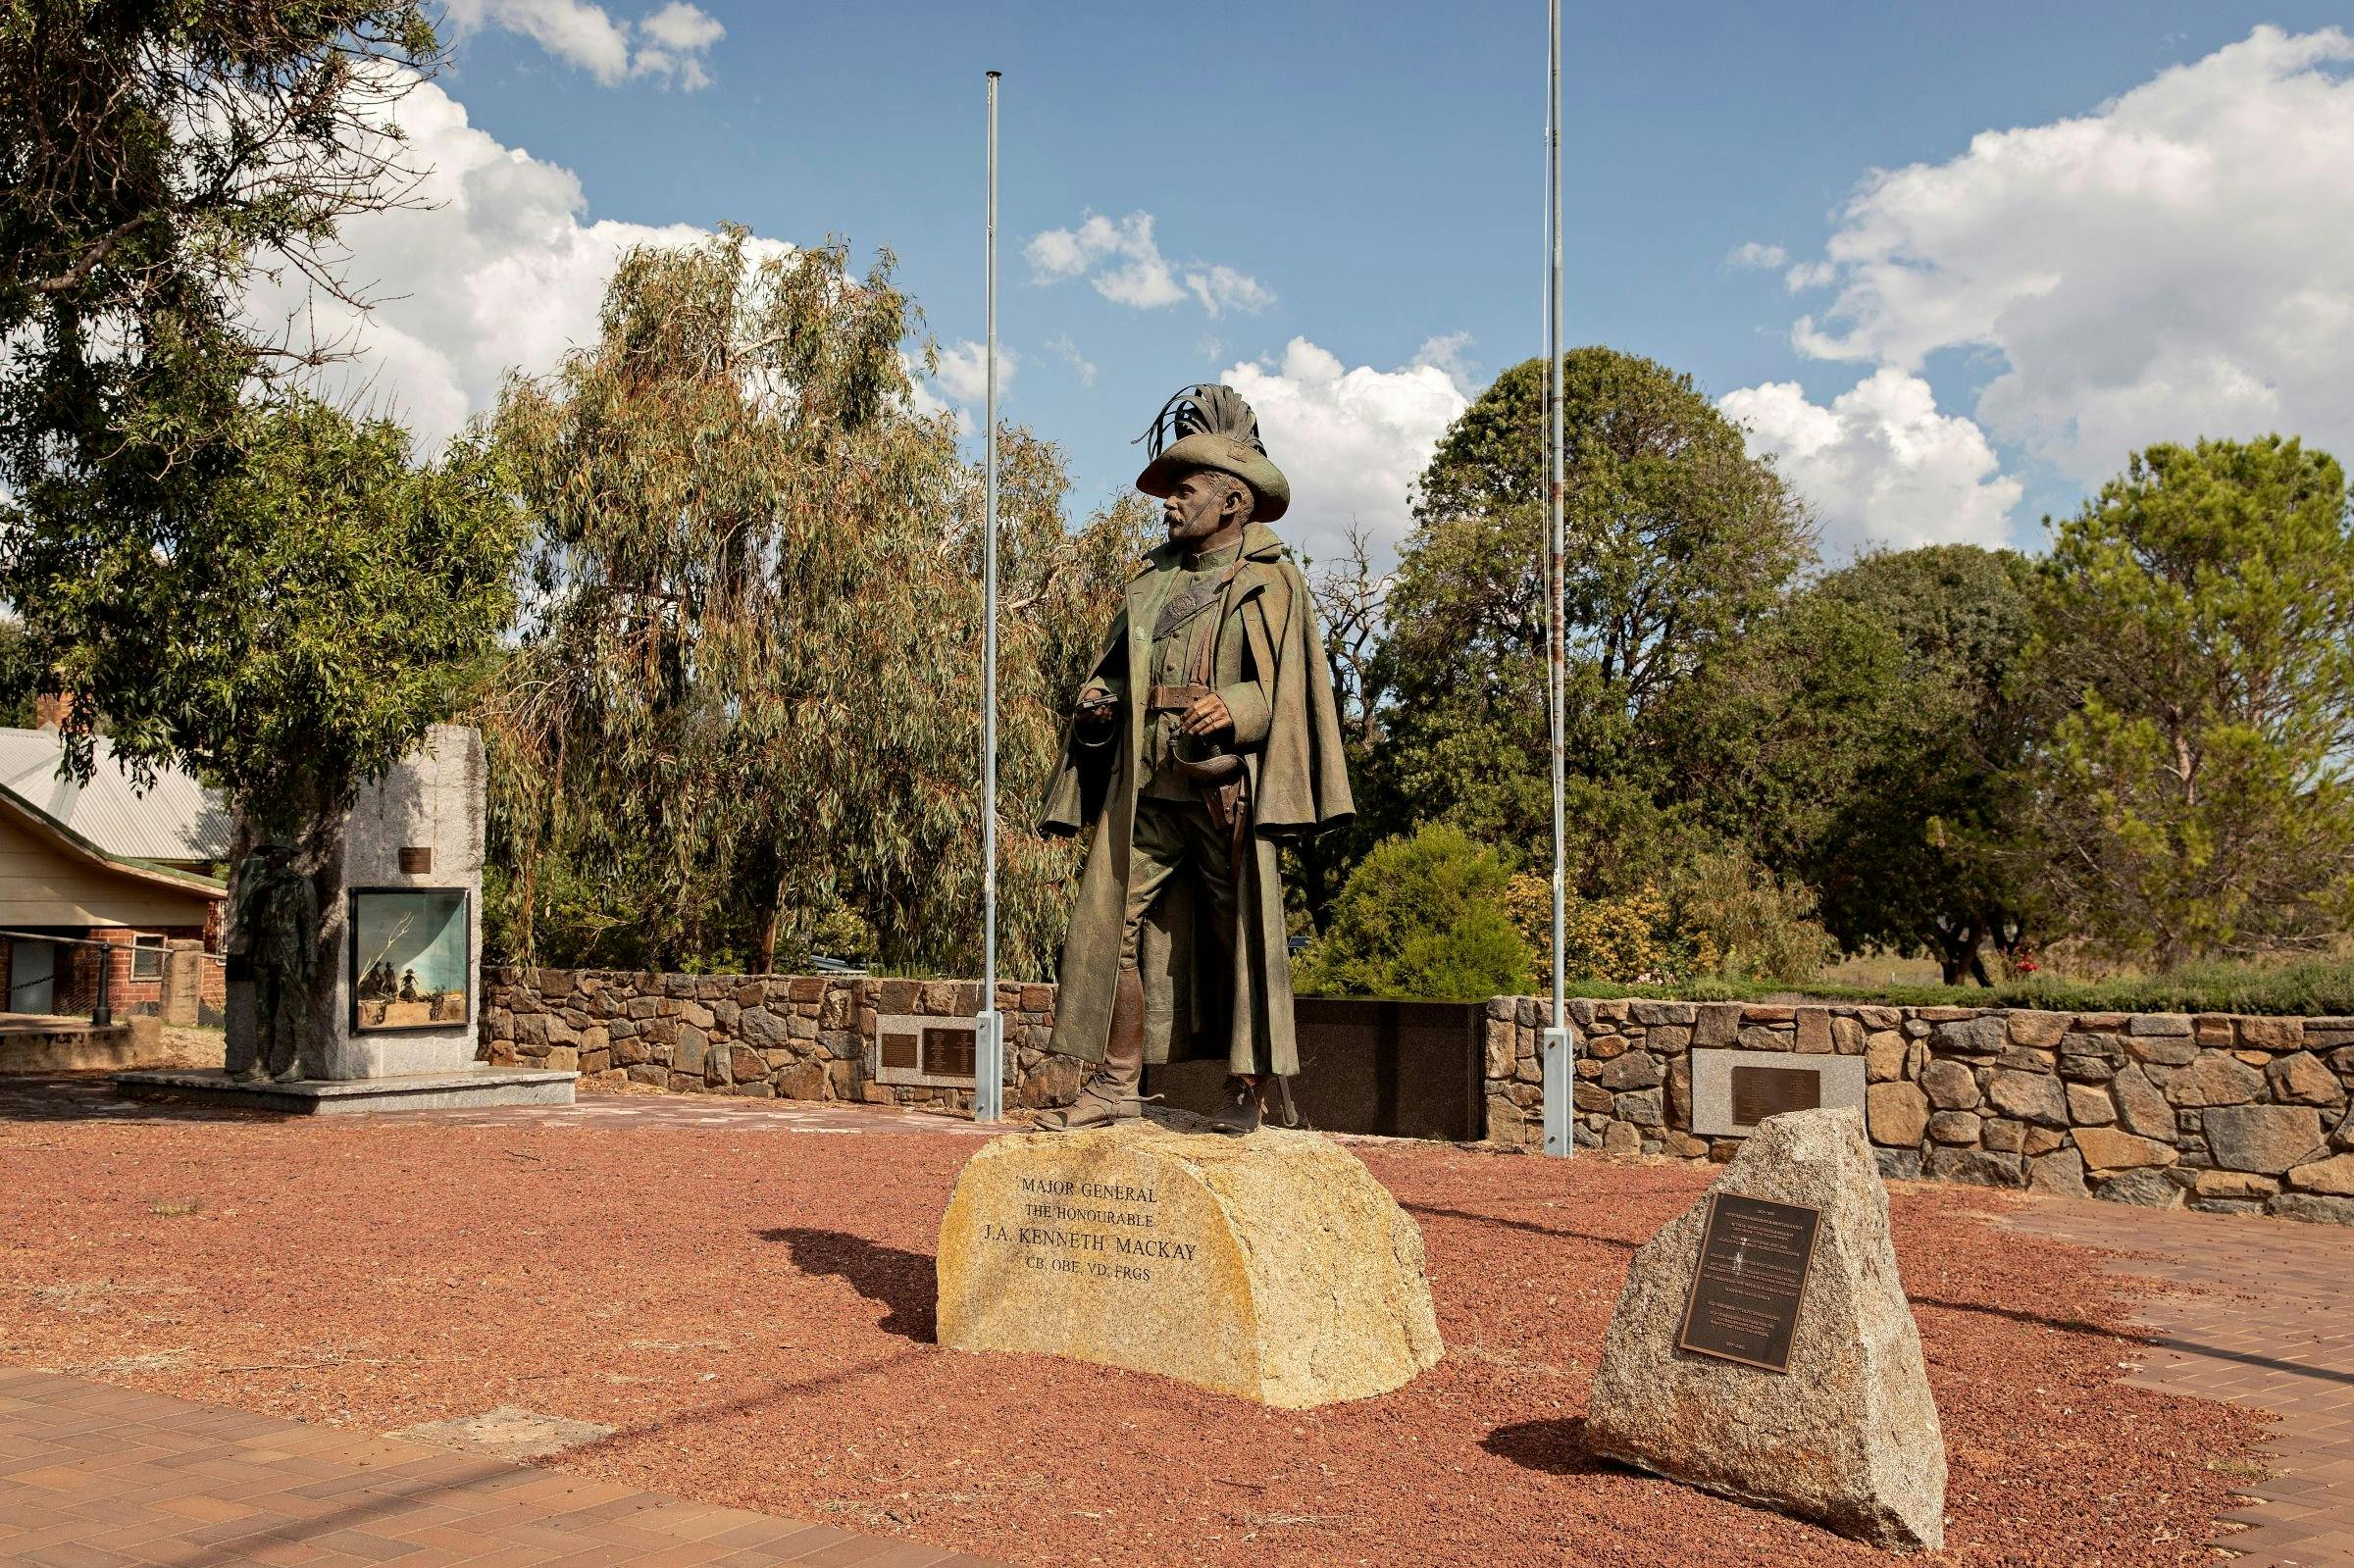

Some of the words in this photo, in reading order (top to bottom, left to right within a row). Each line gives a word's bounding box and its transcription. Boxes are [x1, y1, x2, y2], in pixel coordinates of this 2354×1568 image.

[1021, 1178, 1074, 1195] MAJOR
[1081, 1183, 1157, 1203] GENERAL
[1026, 1204, 1051, 1218] THE
[1056, 1206, 1153, 1227] HONOURABLE
[1019, 1228, 1104, 1250] KENNETH
[1116, 1237, 1197, 1260] MACKAY
[1114, 1264, 1151, 1282] FRGS
